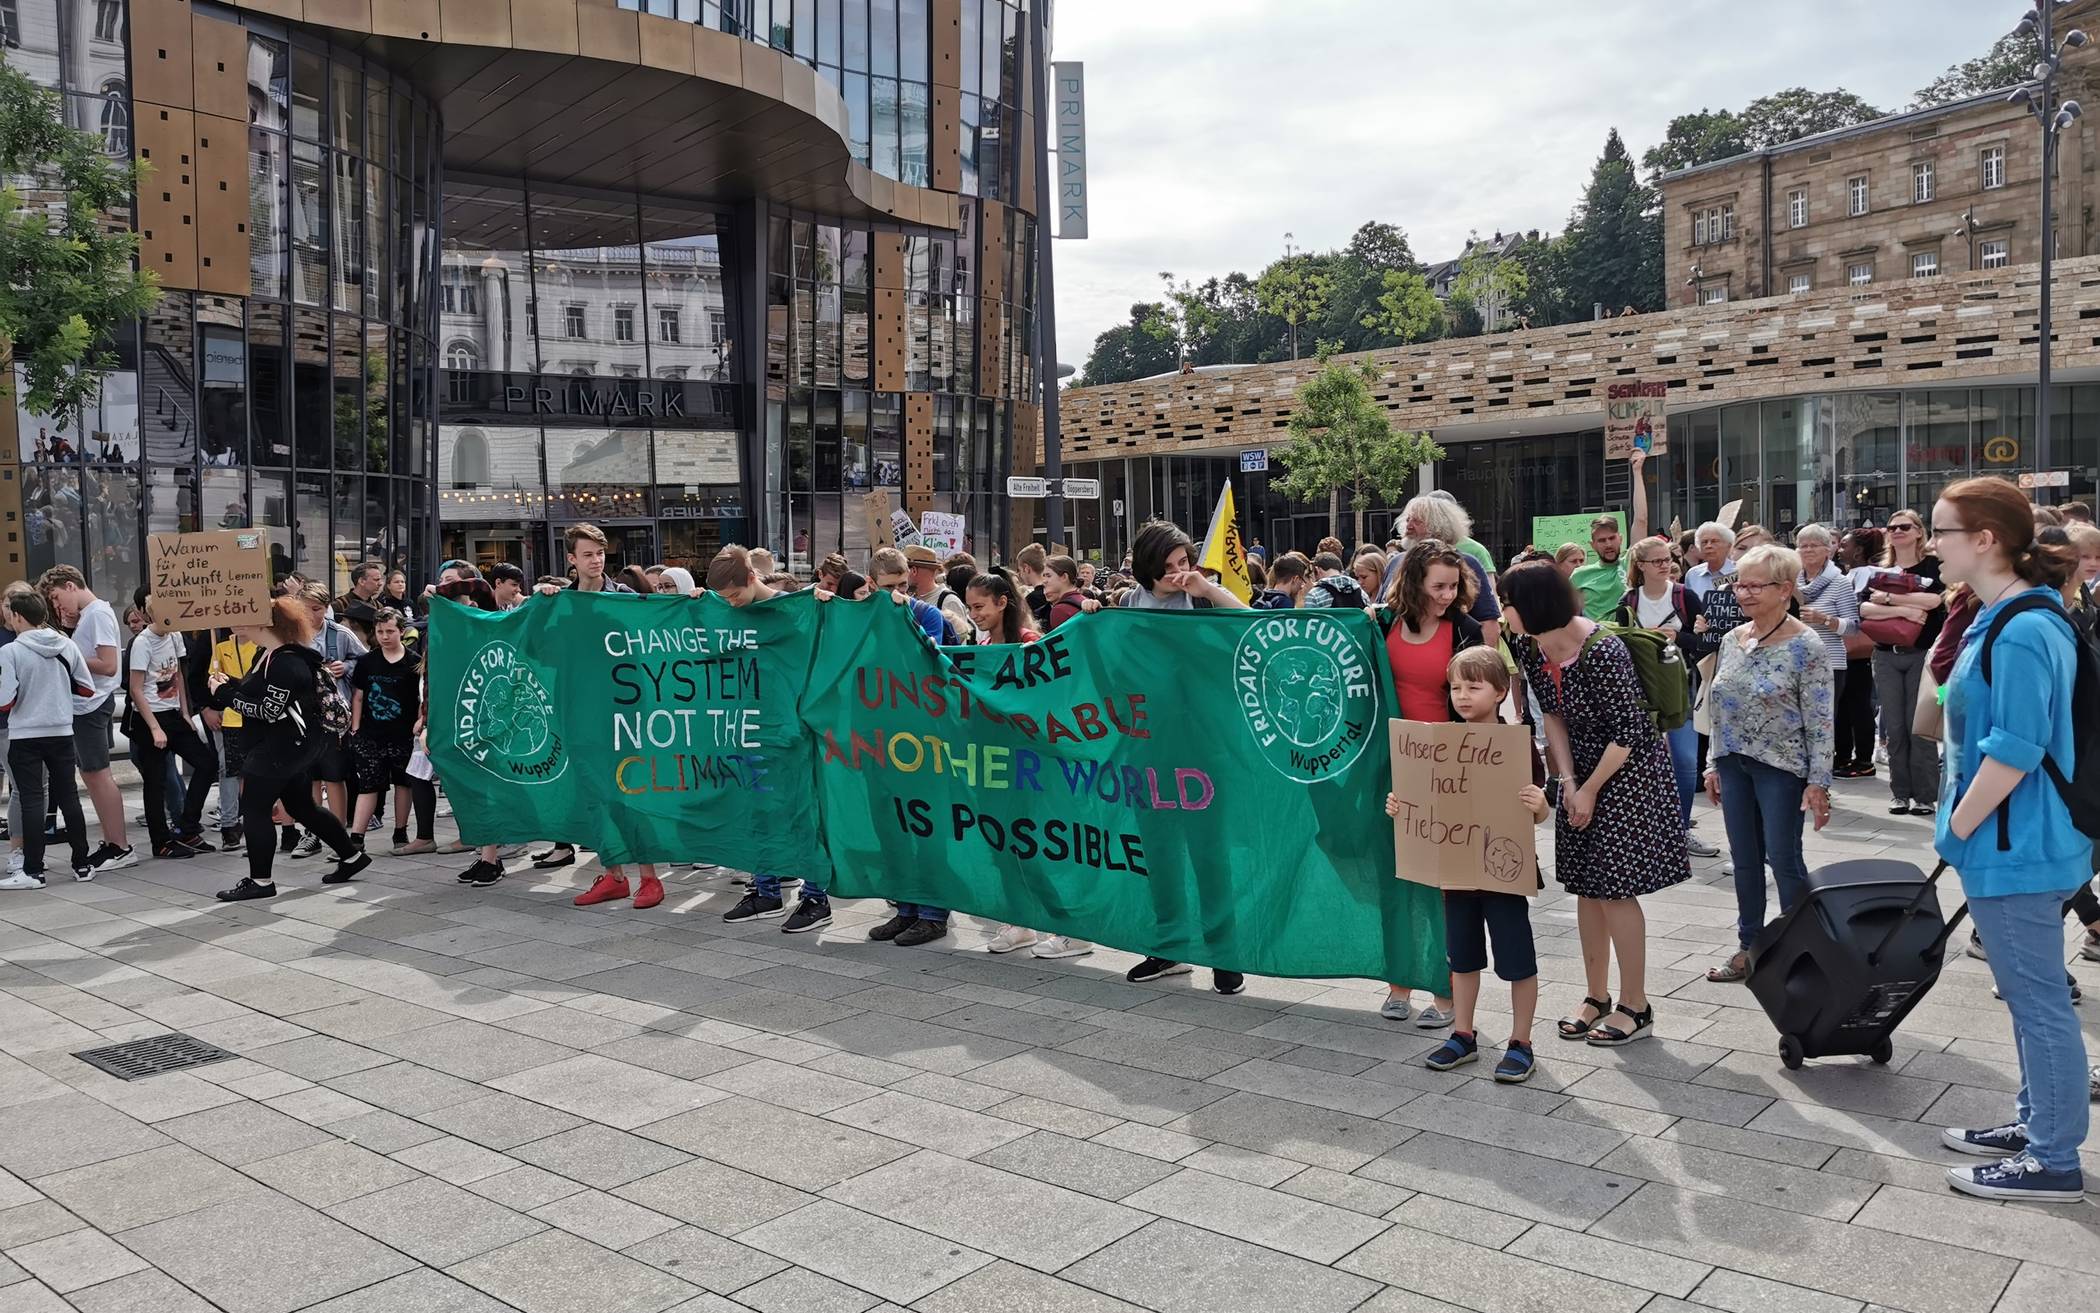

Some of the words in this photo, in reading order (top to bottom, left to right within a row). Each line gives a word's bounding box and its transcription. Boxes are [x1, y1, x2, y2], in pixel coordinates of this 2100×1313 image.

[1060, 78, 1083, 221] PRIMARK
[505, 386, 684, 417] PRIMARK
[1013, 482, 1022, 492] Alte
[1023, 482, 1041, 492] Freiheit
[157, 536, 219, 558] Warum
[922, 536, 957, 550] Klima!
[156, 558, 177, 572] für
[186, 558, 209, 569] die
[157, 569, 223, 588] Zukunft
[156, 588, 191, 599] wenn
[200, 585, 217, 597] ihr
[224, 584, 245, 597] Sie
[1706, 592, 1725, 605] ICH
[177, 597, 259, 619] Zerstört
[1703, 604, 1745, 618] ATMEN
[604, 627, 711, 657] CHANGE
[714, 628, 760, 654] THE
[1255, 618, 1300, 650] FOR
[1702, 632, 1723, 644] NICH
[989, 634, 1072, 691] ARE
[1304, 618, 1370, 699] FUTURE
[611, 657, 761, 706] SYSTEM
[1239, 644, 1278, 748] FRIDAYS
[460, 669, 489, 762] FRIDAYS
[480, 647, 505, 675] FOR
[613, 709, 697, 752] NOT
[706, 708, 762, 749] THE
[507, 731, 563, 778] Wuppertal
[1289, 720, 1363, 776] Wuppertal
[1398, 732, 1449, 763] Unsere
[1456, 731, 1505, 766] Erde
[615, 753, 774, 796] CLIMATE
[823, 728, 1044, 792] ANOTHER
[1056, 755, 1216, 811] WORLD
[1430, 766, 1469, 795] hat
[893, 796, 935, 839] IS
[951, 803, 1150, 877] POSSIBLE
